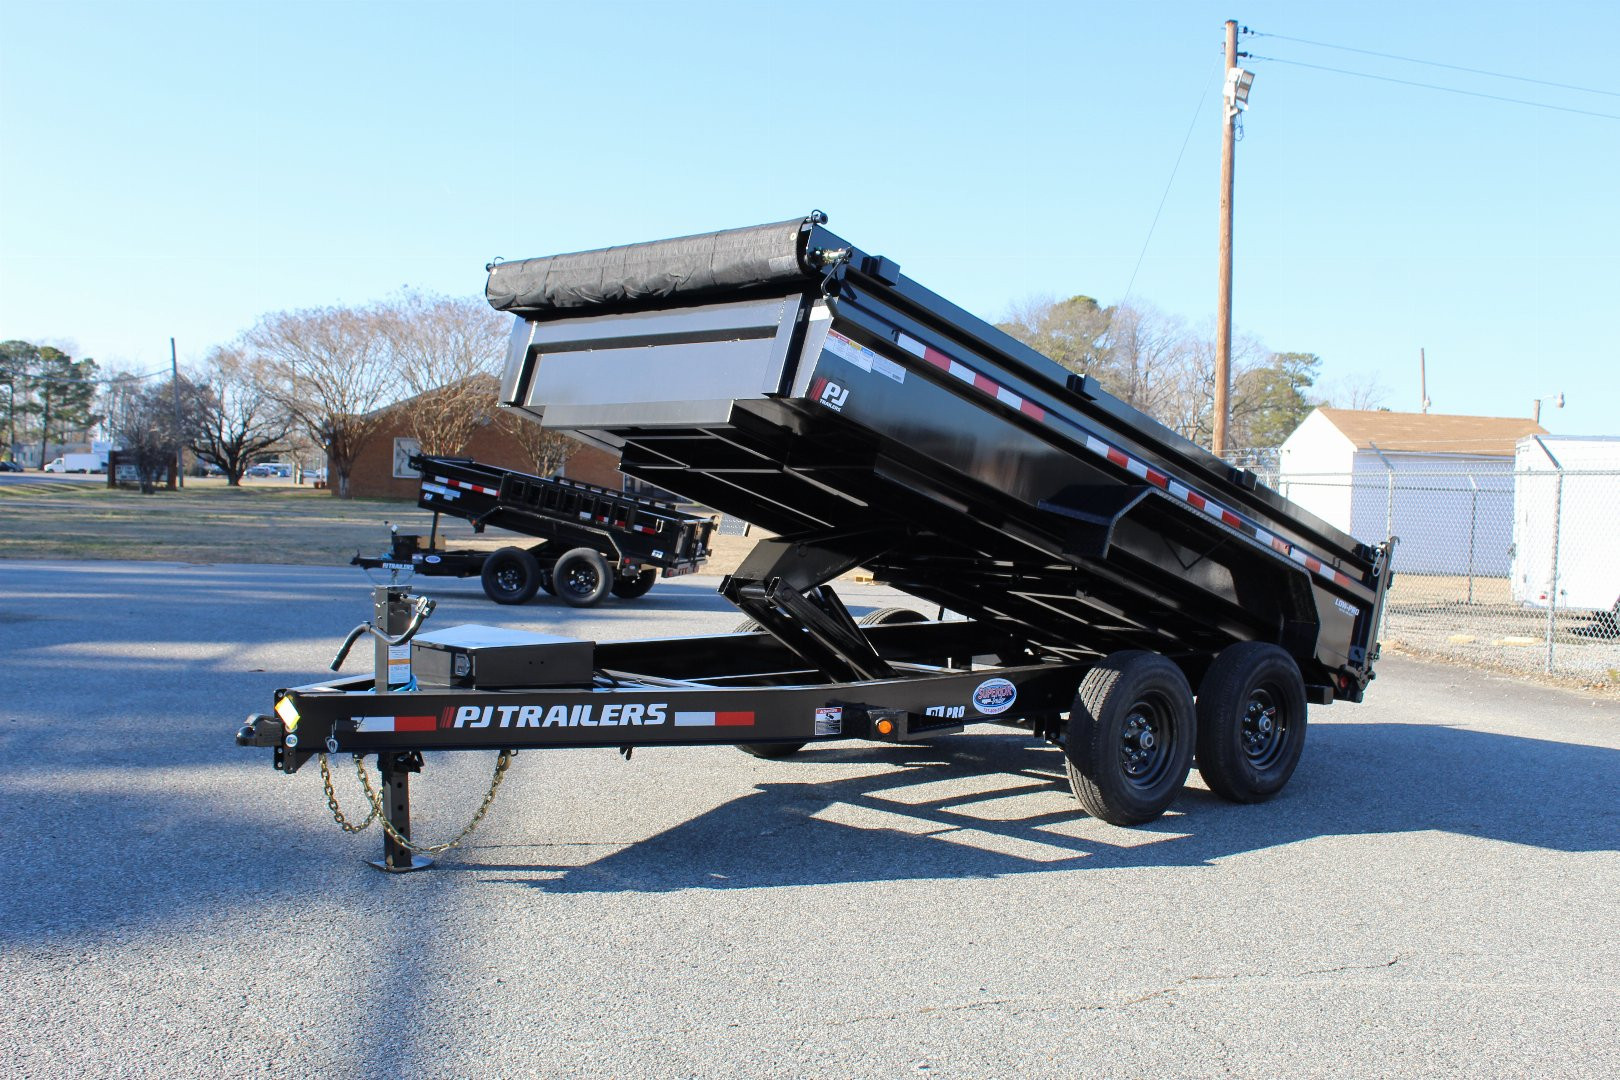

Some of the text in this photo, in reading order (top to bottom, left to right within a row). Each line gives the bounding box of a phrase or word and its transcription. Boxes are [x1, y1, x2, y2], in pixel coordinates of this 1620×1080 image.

[821, 381, 849, 407] PJ
[819, 398, 842, 413] TRAILERS
[453, 703, 668, 729] PJ TRAILERS
[946, 705, 965, 719] PRO
